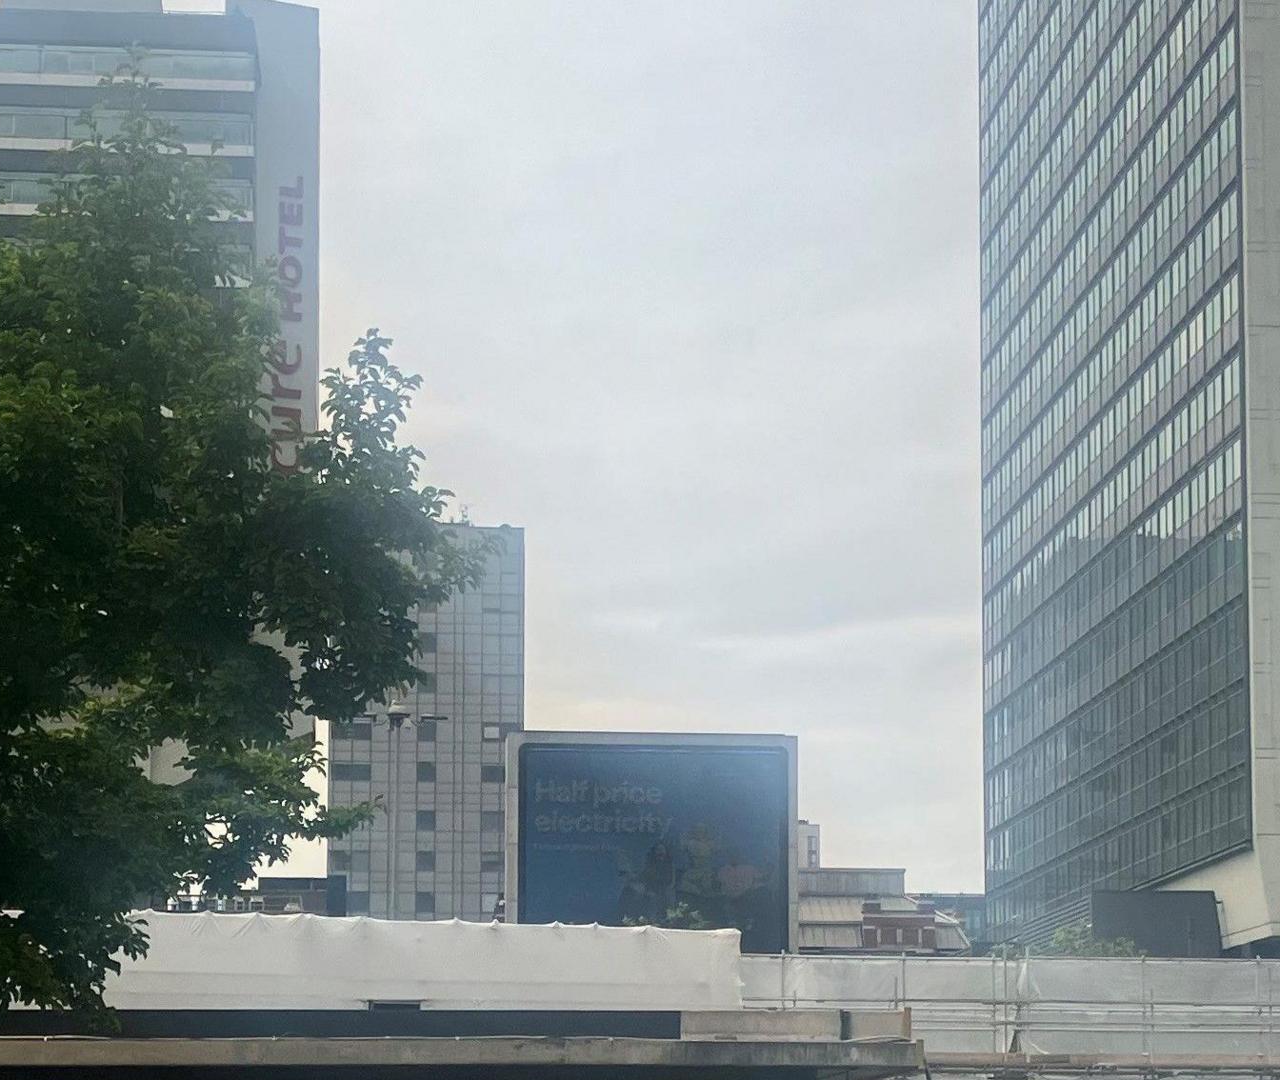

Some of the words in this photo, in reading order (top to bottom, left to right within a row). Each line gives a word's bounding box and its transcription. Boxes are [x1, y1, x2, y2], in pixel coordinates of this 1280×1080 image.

[278, 175, 305, 322] HOTEL
[270, 340, 302, 474] cure
[534, 779, 589, 803] Half
[593, 780, 663, 809] price
[534, 811, 674, 840] electricity
